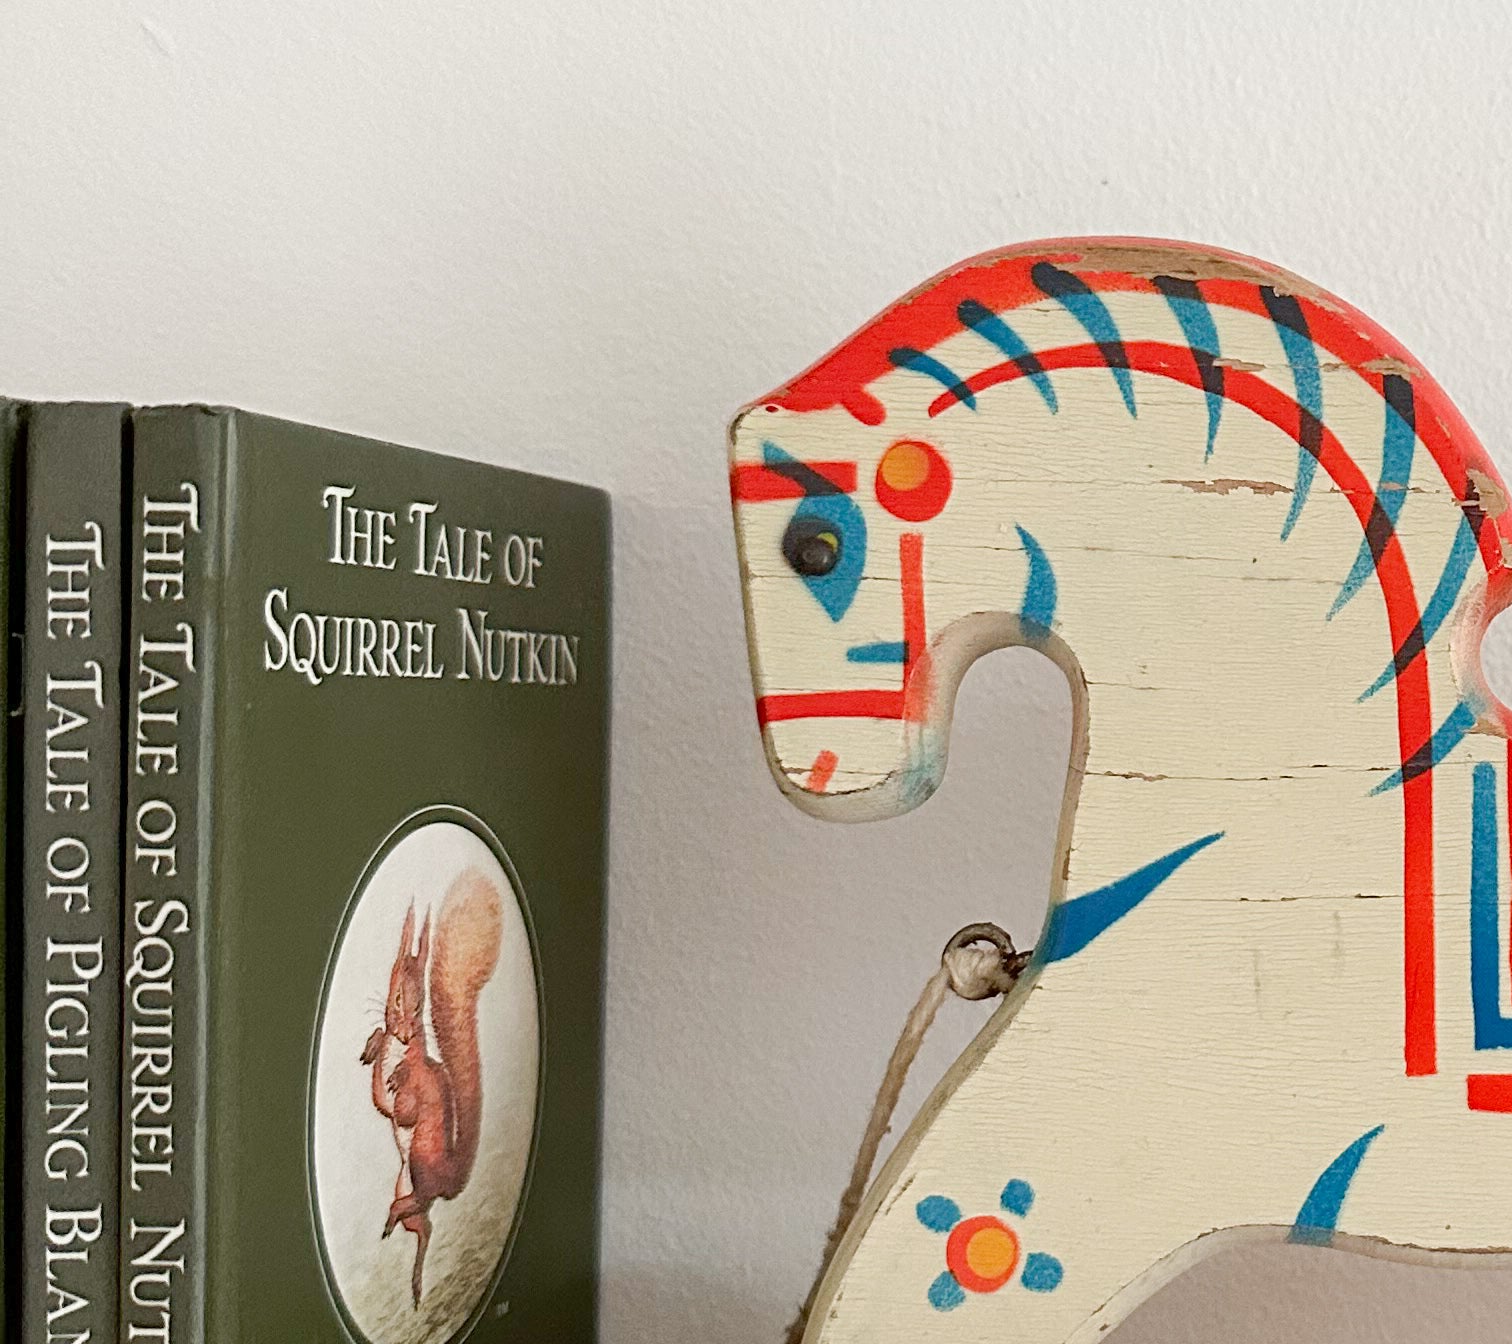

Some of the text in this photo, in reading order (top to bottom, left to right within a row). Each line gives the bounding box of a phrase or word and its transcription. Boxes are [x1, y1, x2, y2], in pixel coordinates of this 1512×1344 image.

[46, 522, 104, 640] THE
[141, 482, 200, 603] THE
[322, 484, 544, 589] THE TALE OF
[264, 588, 580, 686] SQUIRREL NUTKIN
[45, 661, 104, 813] TALE
[135, 622, 196, 776] TALE
[45, 837, 90, 914] OF
[134, 799, 178, 878] OF
[44, 937, 103, 1182] PIGLING
[126, 899, 190, 1192] SQUIRREL
